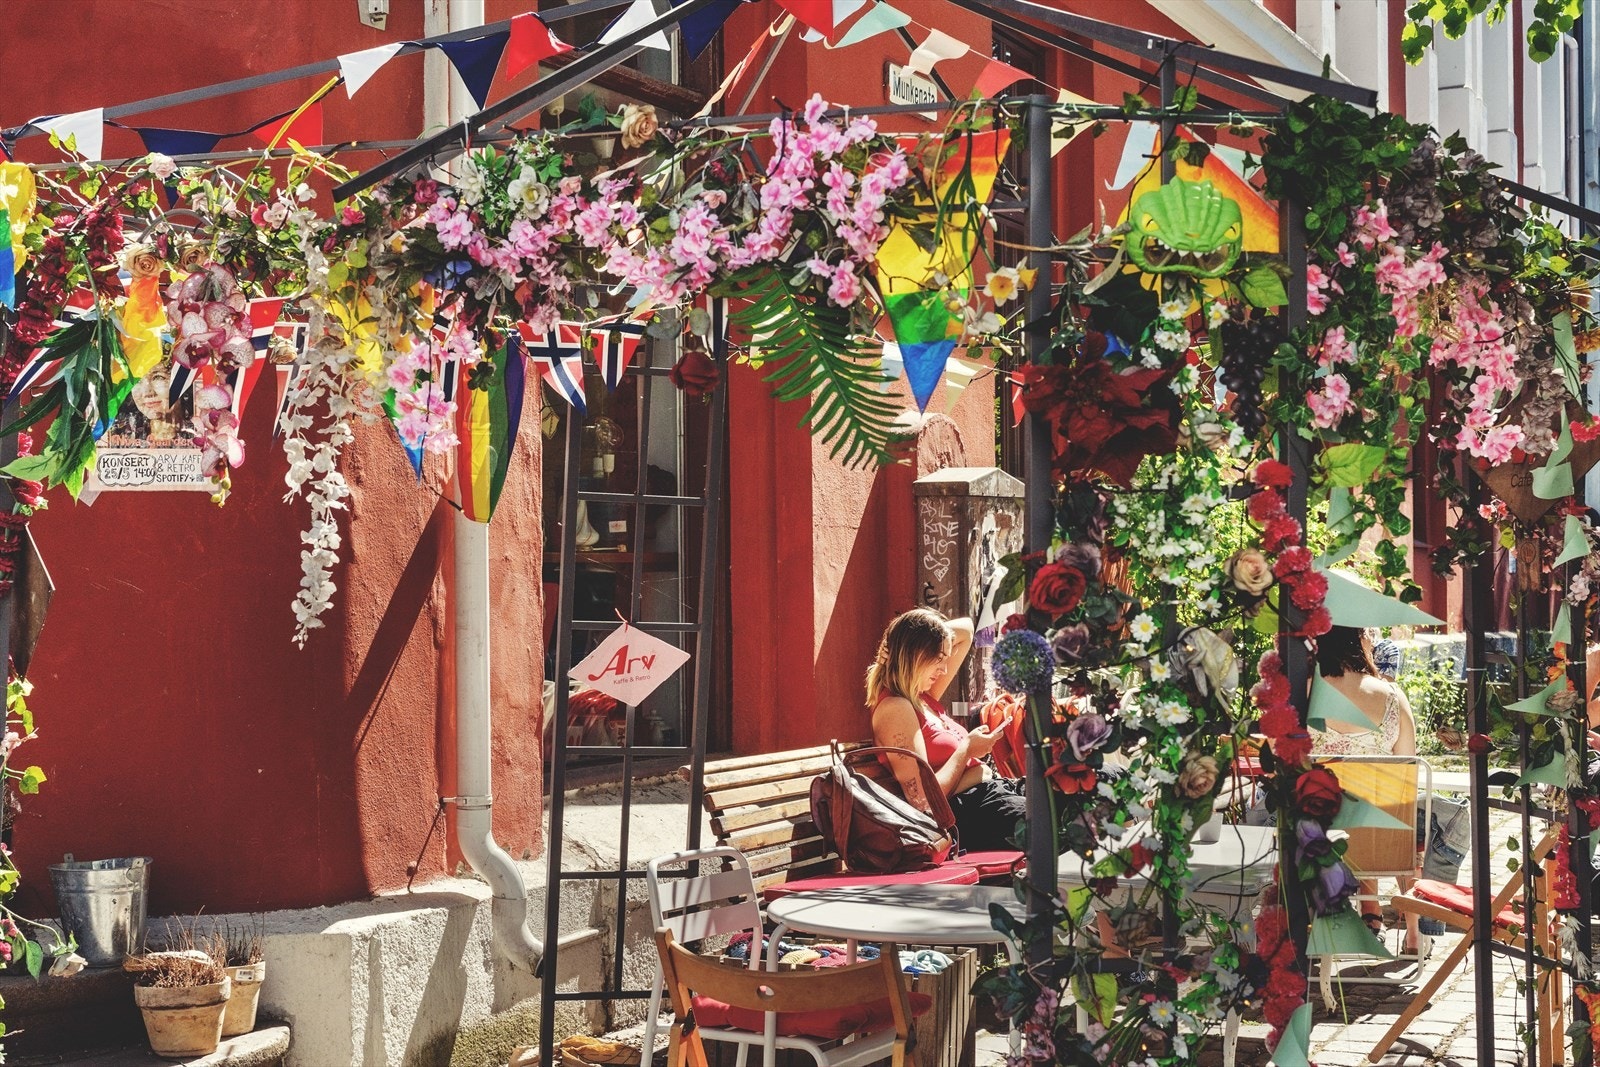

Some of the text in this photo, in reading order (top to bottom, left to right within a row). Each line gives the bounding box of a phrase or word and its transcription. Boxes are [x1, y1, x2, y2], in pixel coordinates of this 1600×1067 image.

[102, 457, 150, 468] KONSERT
[156, 454, 201, 464] ARV KAFF
[104, 467, 156, 479] 25/5 14:00
[157, 464, 195, 472] & RETRO
[156, 474, 190, 482] SPOTIFY
[588, 645, 656, 681] Arv
